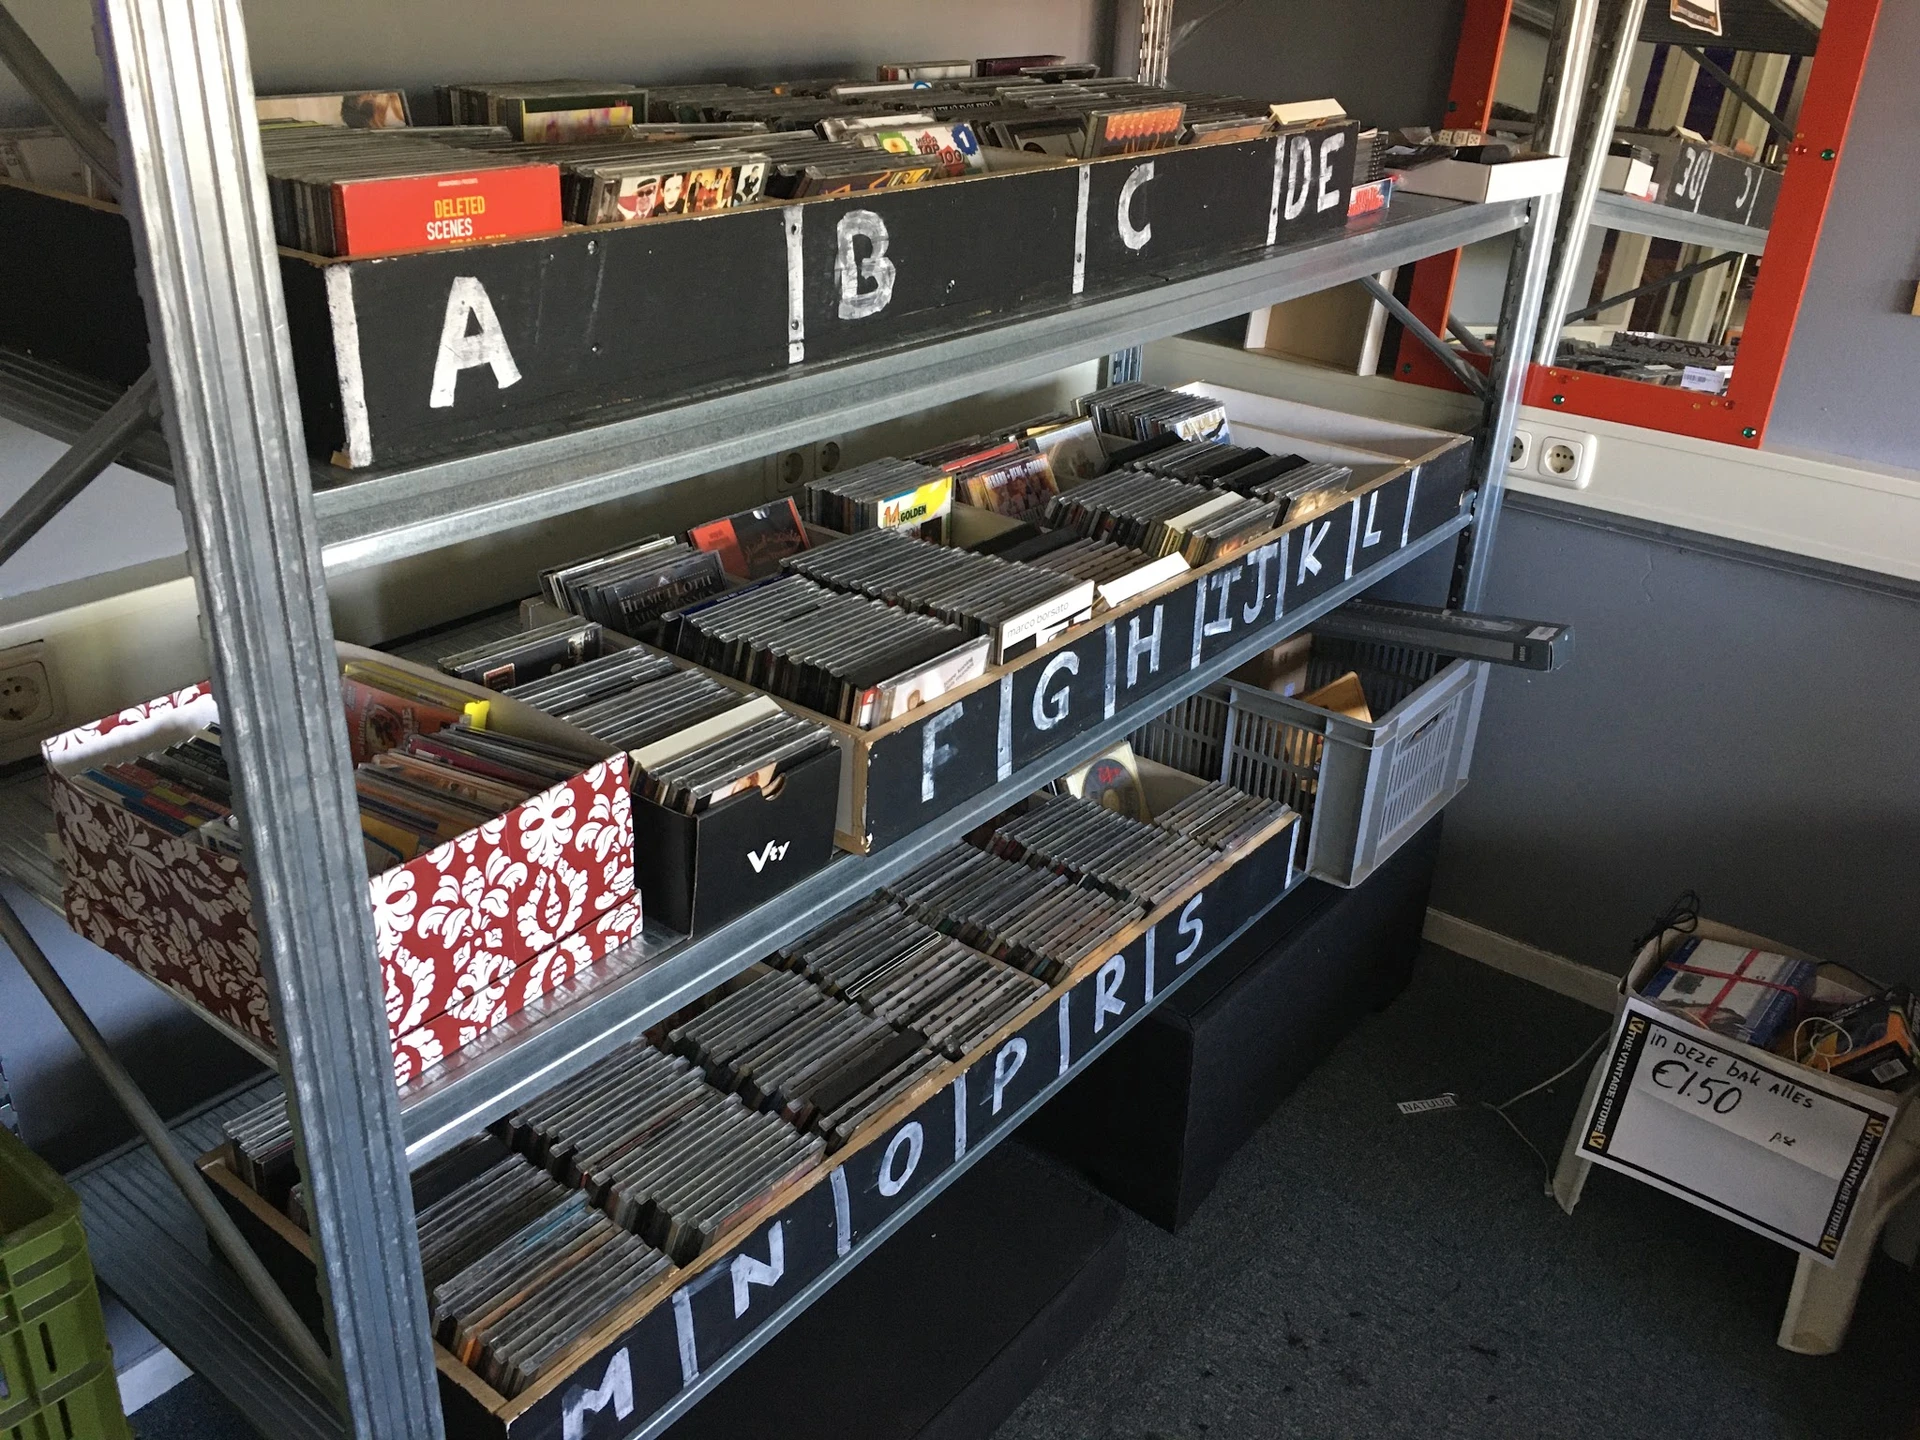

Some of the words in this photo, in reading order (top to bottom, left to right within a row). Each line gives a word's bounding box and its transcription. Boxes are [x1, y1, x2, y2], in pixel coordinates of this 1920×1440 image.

[918, 145, 940, 155] TOP
[940, 150, 964, 166] 100
[426, 217, 473, 240] SCENES
[434, 196, 485, 218] DELETED
[1117, 160, 1154, 250] C
[834, 210, 896, 319] B
[429, 276, 522, 408] A
[884, 501, 900, 529] 14
[900, 504, 927, 522] GOLDEN
[1362, 490, 1382, 548] L
[1297, 520, 1331, 586] K
[621, 587, 672, 614] HELMUT
[674, 575, 712, 595] LOTTI
[1007, 619, 1036, 638] marco
[1036, 602, 1069, 625] borsato
[1127, 604, 1164, 689] H
[1032, 651, 1080, 731] G
[921, 701, 964, 803] F
[1175, 892, 1204, 965] S
[1094, 954, 1126, 1034] R
[1622, 1030, 1637, 1051] THE
[1650, 1029, 1667, 1048] in
[1673, 1042, 1718, 1068] DEZE
[991, 1037, 1028, 1116] P
[1606, 1051, 1630, 1098] VINTAGE
[1402, 1098, 1454, 1112] NATUUR
[1595, 1097, 1614, 1132] STORE
[878, 1121, 924, 1197] O
[1840, 1156, 1865, 1204] VINTAGE
[1826, 1203, 1847, 1238] STORE
[730, 1220, 785, 1320] N
[562, 1347, 634, 1440] M
